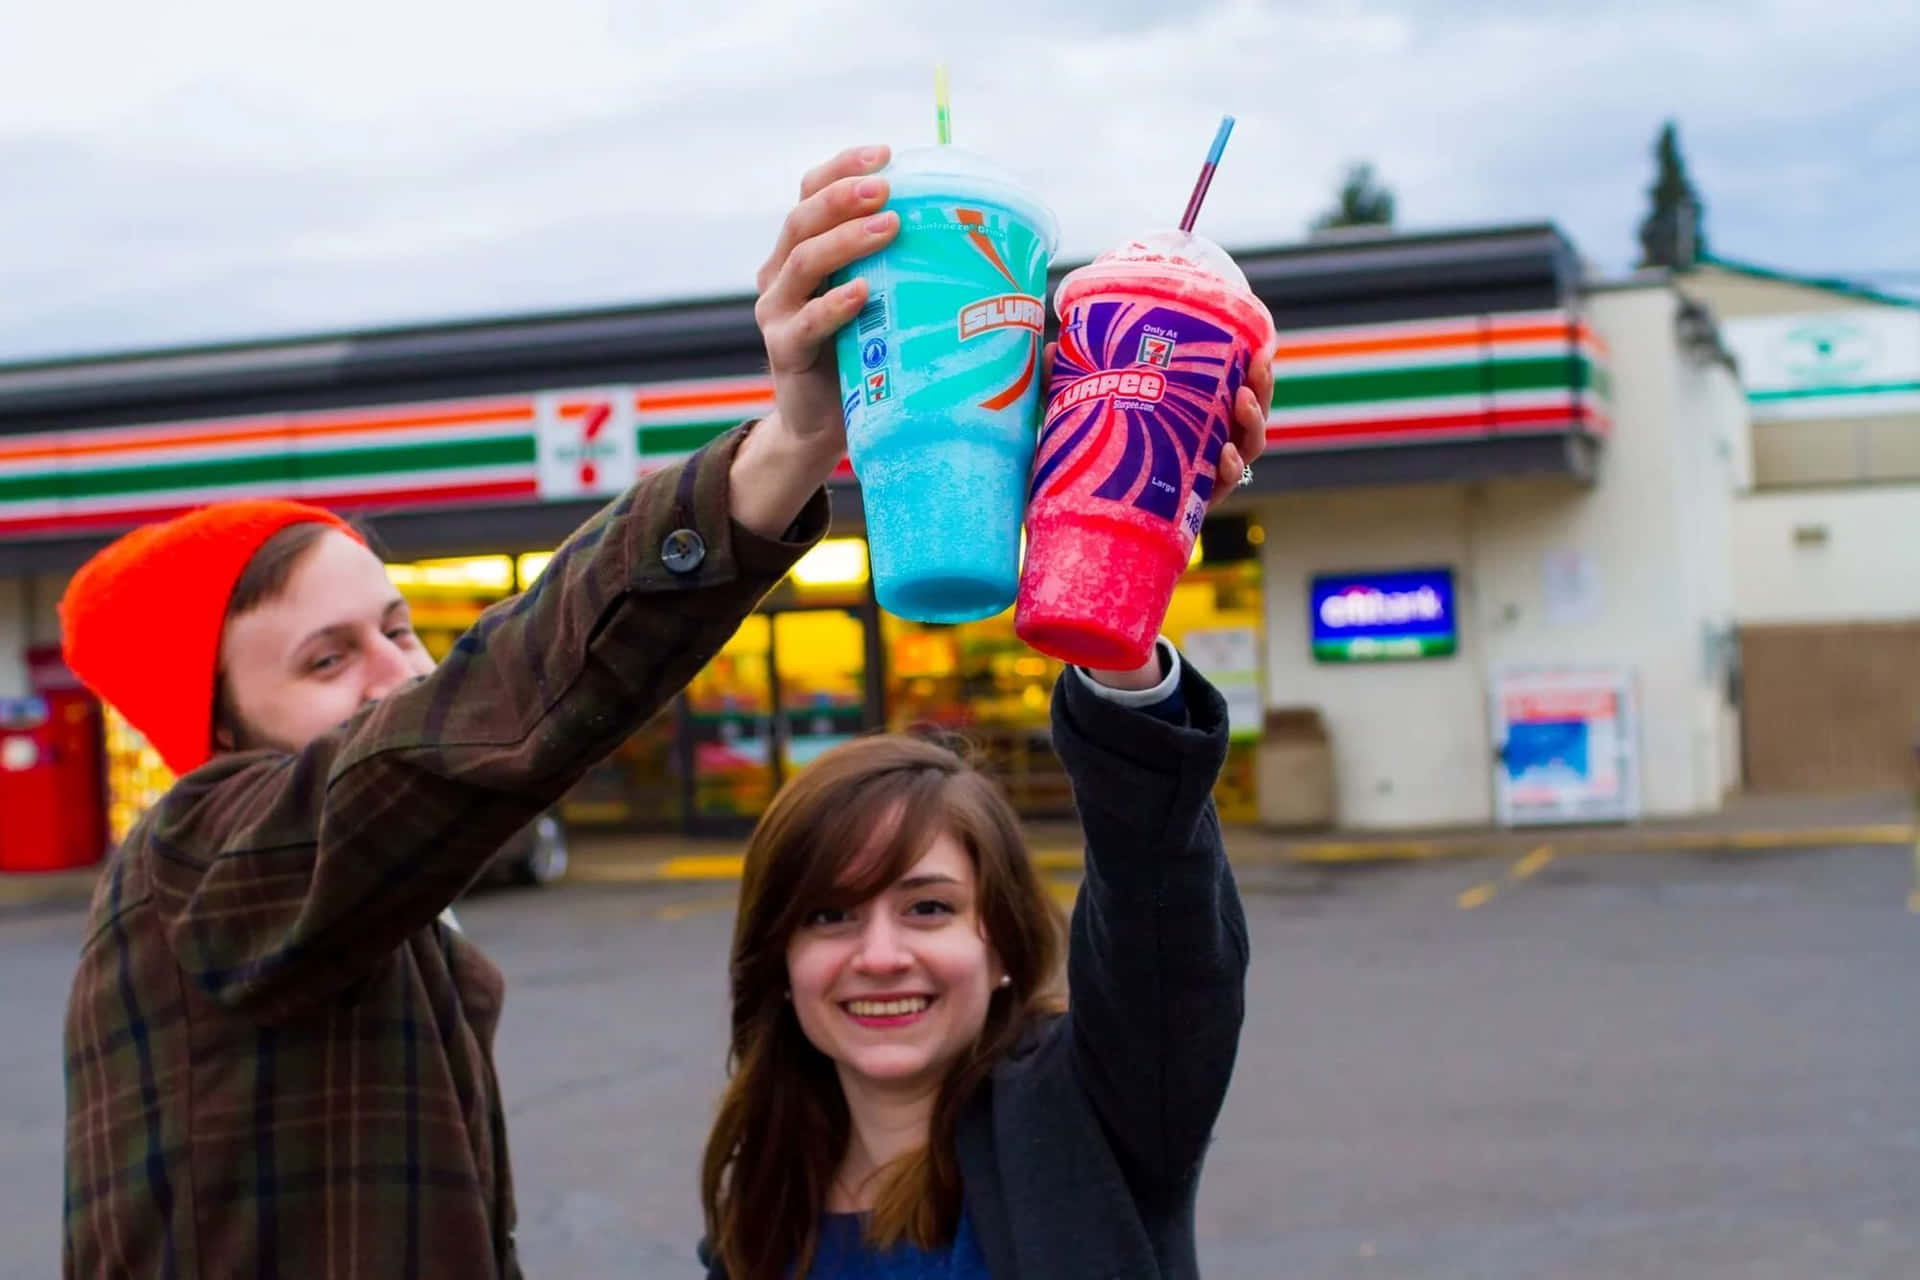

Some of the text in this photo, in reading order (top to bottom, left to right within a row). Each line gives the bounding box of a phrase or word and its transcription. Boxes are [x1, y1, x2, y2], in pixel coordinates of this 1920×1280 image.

[1143, 324, 1178, 338] Only At
[1151, 476, 1176, 493] Large
